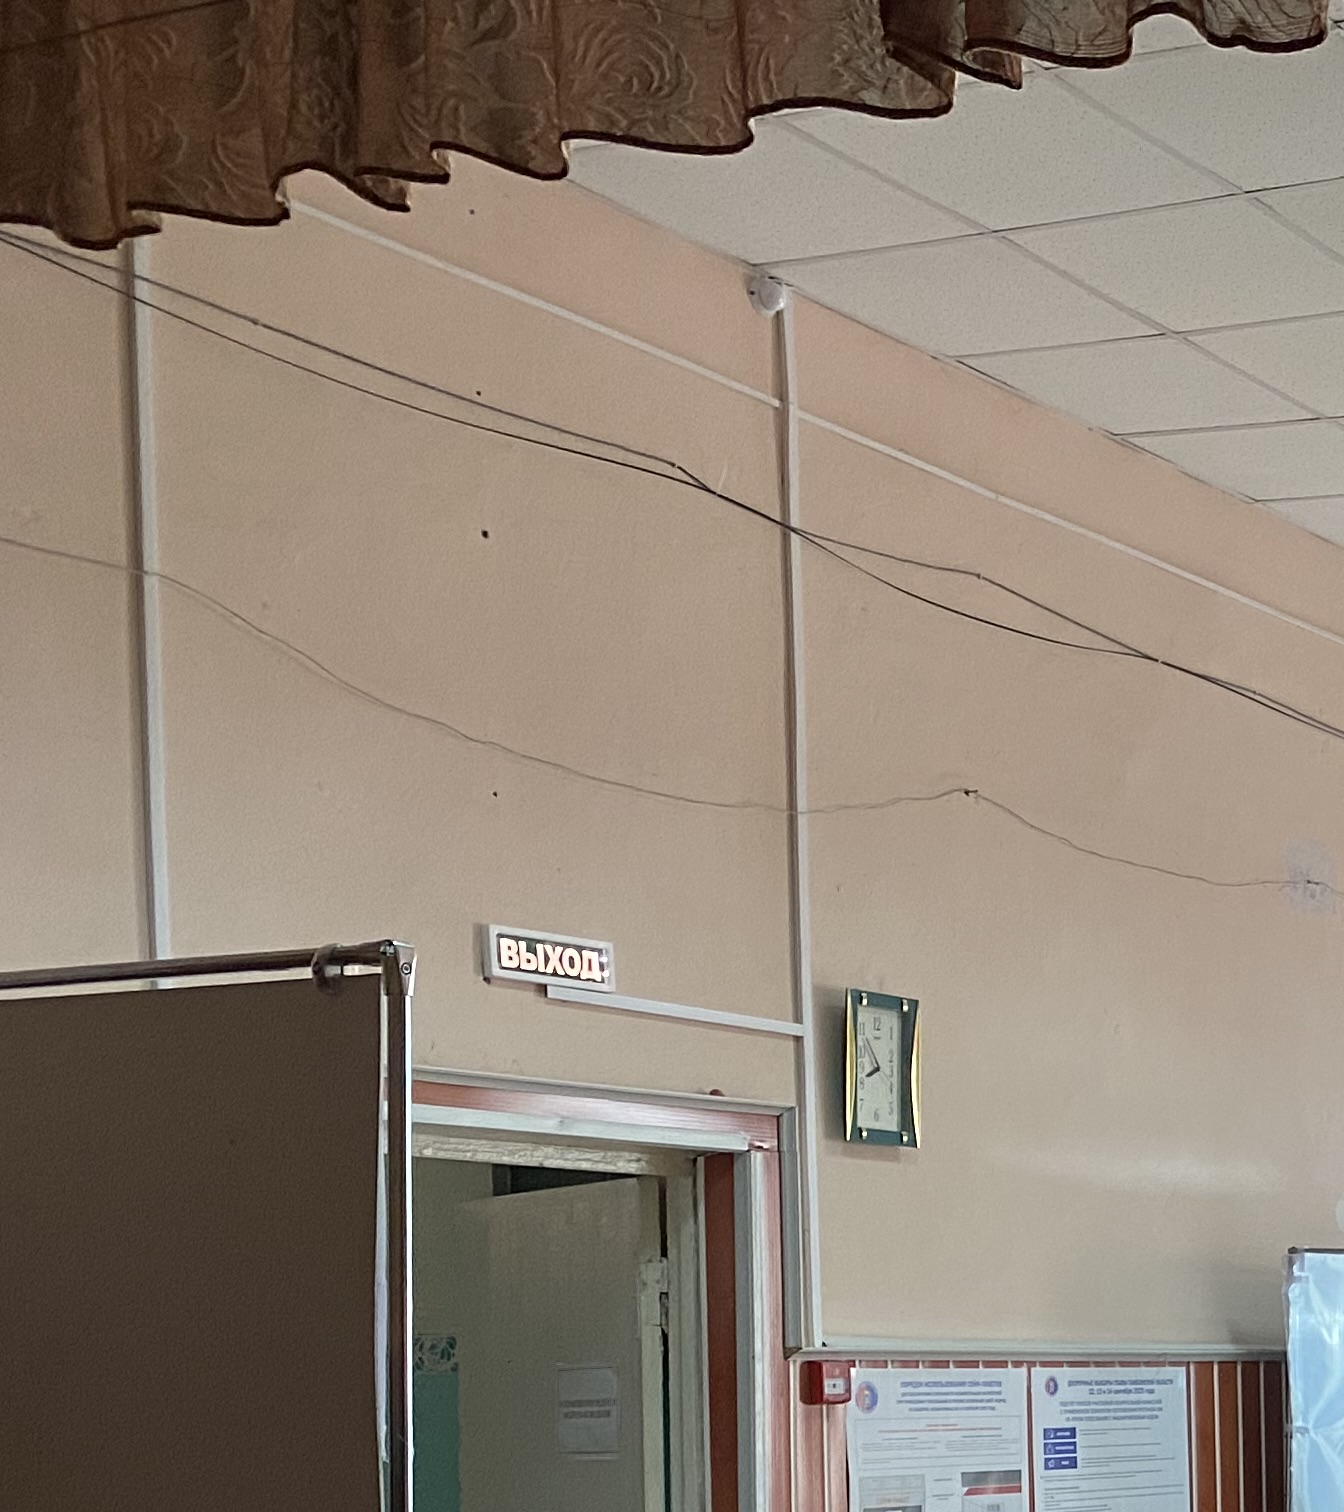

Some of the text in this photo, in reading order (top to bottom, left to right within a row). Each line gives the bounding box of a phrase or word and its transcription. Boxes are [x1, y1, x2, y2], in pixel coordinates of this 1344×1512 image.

[499, 937, 602, 982] ВЫХОД
[859, 1022, 865, 1036] 11
[873, 1016, 882, 1031] 12
[889, 1026, 893, 1041] 1
[888, 1049, 894, 1063] 2
[859, 1060, 865, 1074] 9
[859, 1076, 865, 1091] 8
[858, 1098, 865, 1112] 7
[873, 1108, 880, 1122] 6
